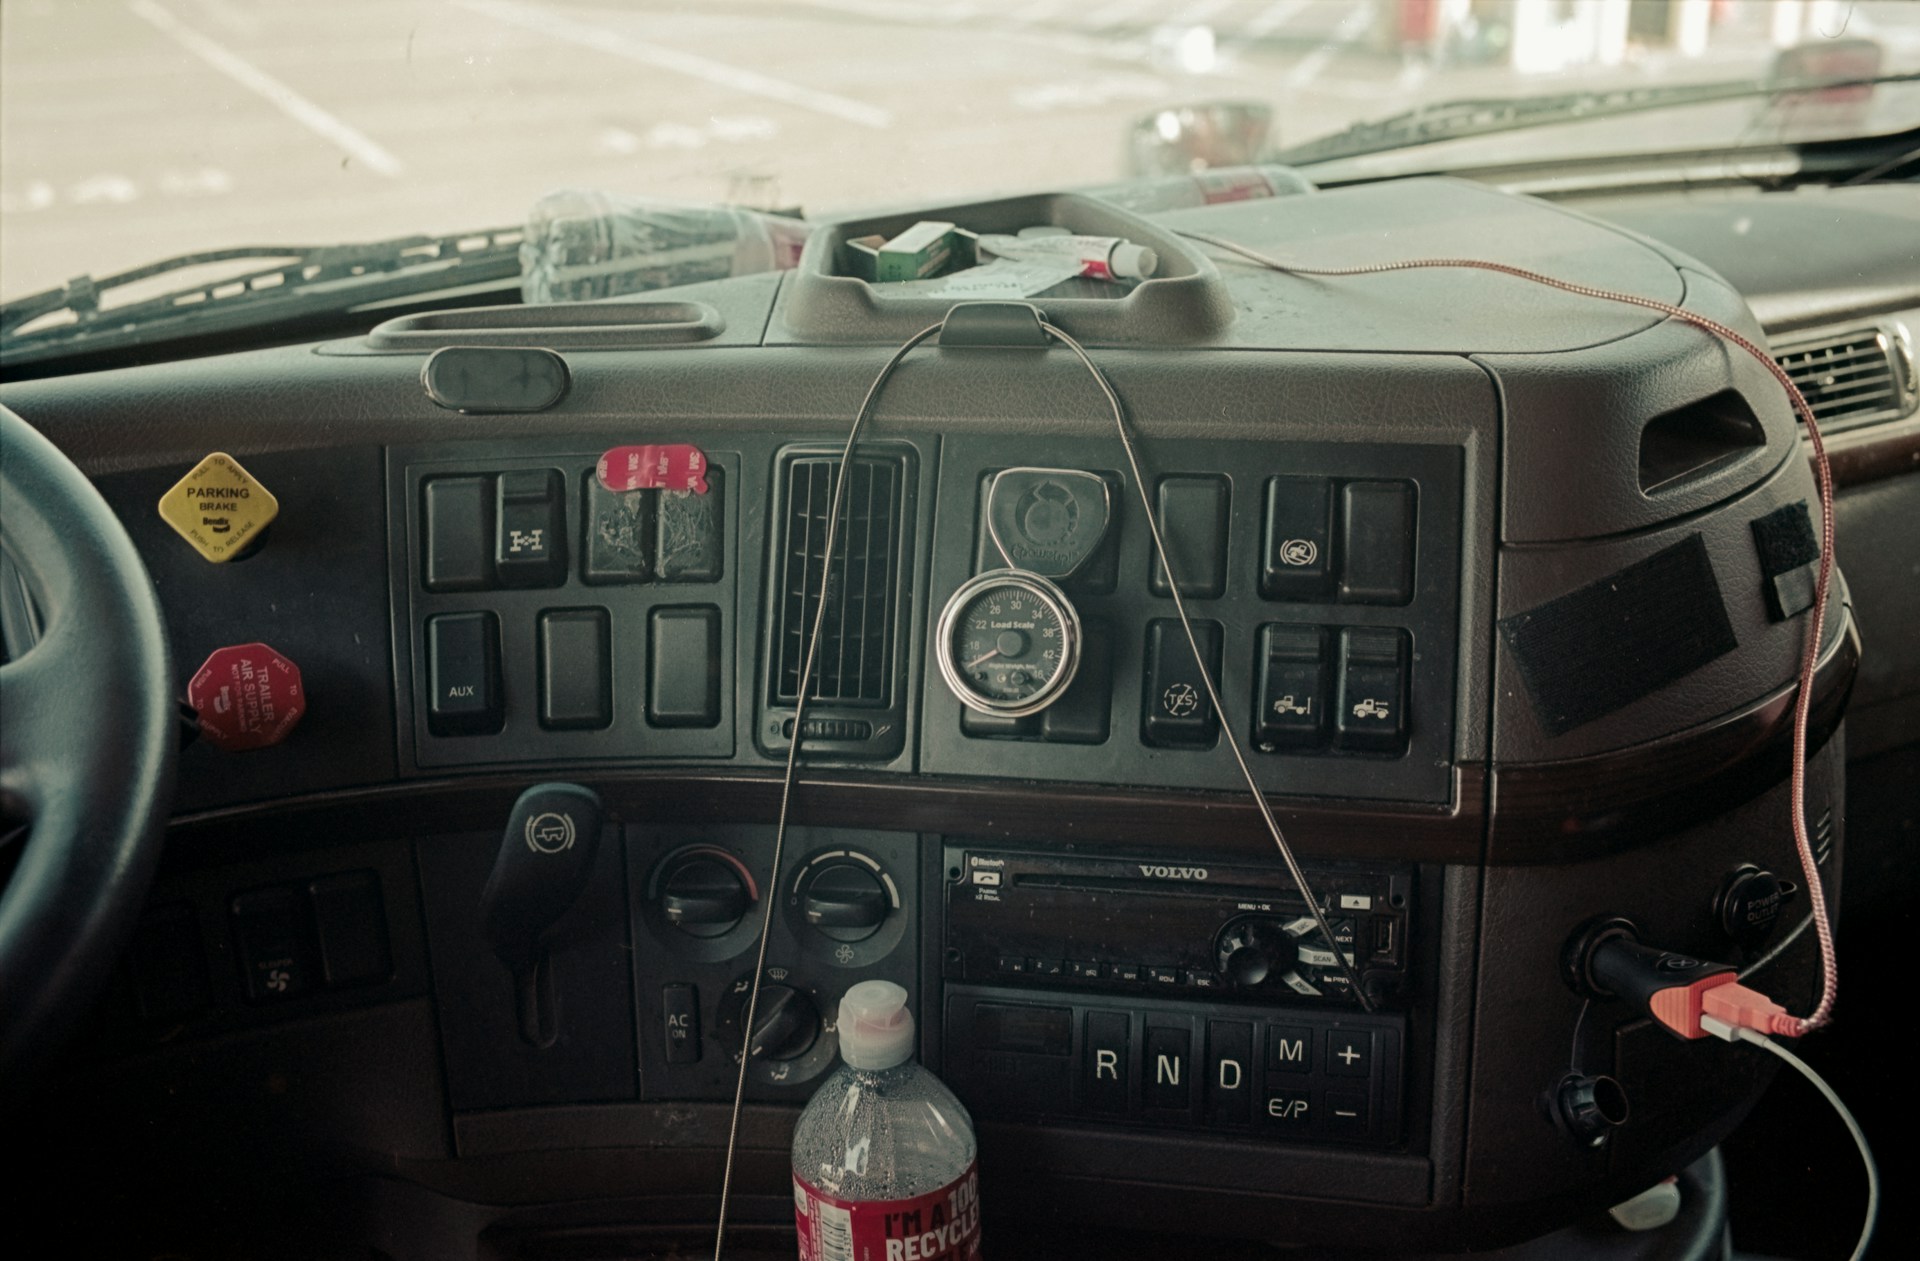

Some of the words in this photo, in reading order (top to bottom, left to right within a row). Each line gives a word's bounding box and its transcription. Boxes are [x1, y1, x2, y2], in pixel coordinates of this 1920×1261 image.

[628, 453, 639, 471] 3M
[689, 452, 700, 470] 3M
[192, 466, 211, 480] PULL
[214, 458, 226, 466] TO
[227, 466, 249, 484] APPLY
[187, 487, 250, 499] PARKING
[200, 502, 238, 512] BRAKE
[190, 529, 209, 547] PUSH
[225, 521, 255, 547] RELEASE
[990, 605, 1000, 614] 26
[1011, 601, 1021, 609] 30
[1032, 610, 1042, 619] 34
[976, 621, 986, 629] 22
[991, 621, 1011, 629] Load
[1013, 621, 1035, 629] Scale
[1043, 628, 1053, 638] 38
[970, 641, 979, 650] 18
[1043, 650, 1054, 659] 42
[231, 664, 240, 679] NOT
[241, 659, 254, 680] AIR
[272, 658, 290, 674] PULL
[290, 685, 298, 695] TO
[1033, 669, 1043, 679] 46
[195, 669, 212, 688] PUSH
[257, 666, 274, 721] TRAILER
[449, 686, 474, 697] AUX
[197, 699, 204, 709] TO
[1169, 694, 1193, 706] TCS
[244, 683, 262, 733] SUPPLY
[1139, 865, 1208, 880] VOLVO
[1747, 892, 1780, 910] POWER
[1747, 903, 1779, 921] OUTLET
[1335, 935, 1353, 943] NEXT
[1313, 954, 1331, 962] SCAN
[668, 1014, 688, 1027] AC
[672, 1029, 686, 1039] ON
[1279, 1039, 1303, 1062] M
[1096, 1050, 1118, 1080] R
[1157, 1055, 1180, 1086] N
[1219, 1059, 1241, 1089] D
[1268, 1098, 1308, 1118] E/P
[885, 1208, 922, 1237] I'M
[930, 1203, 945, 1231] A
